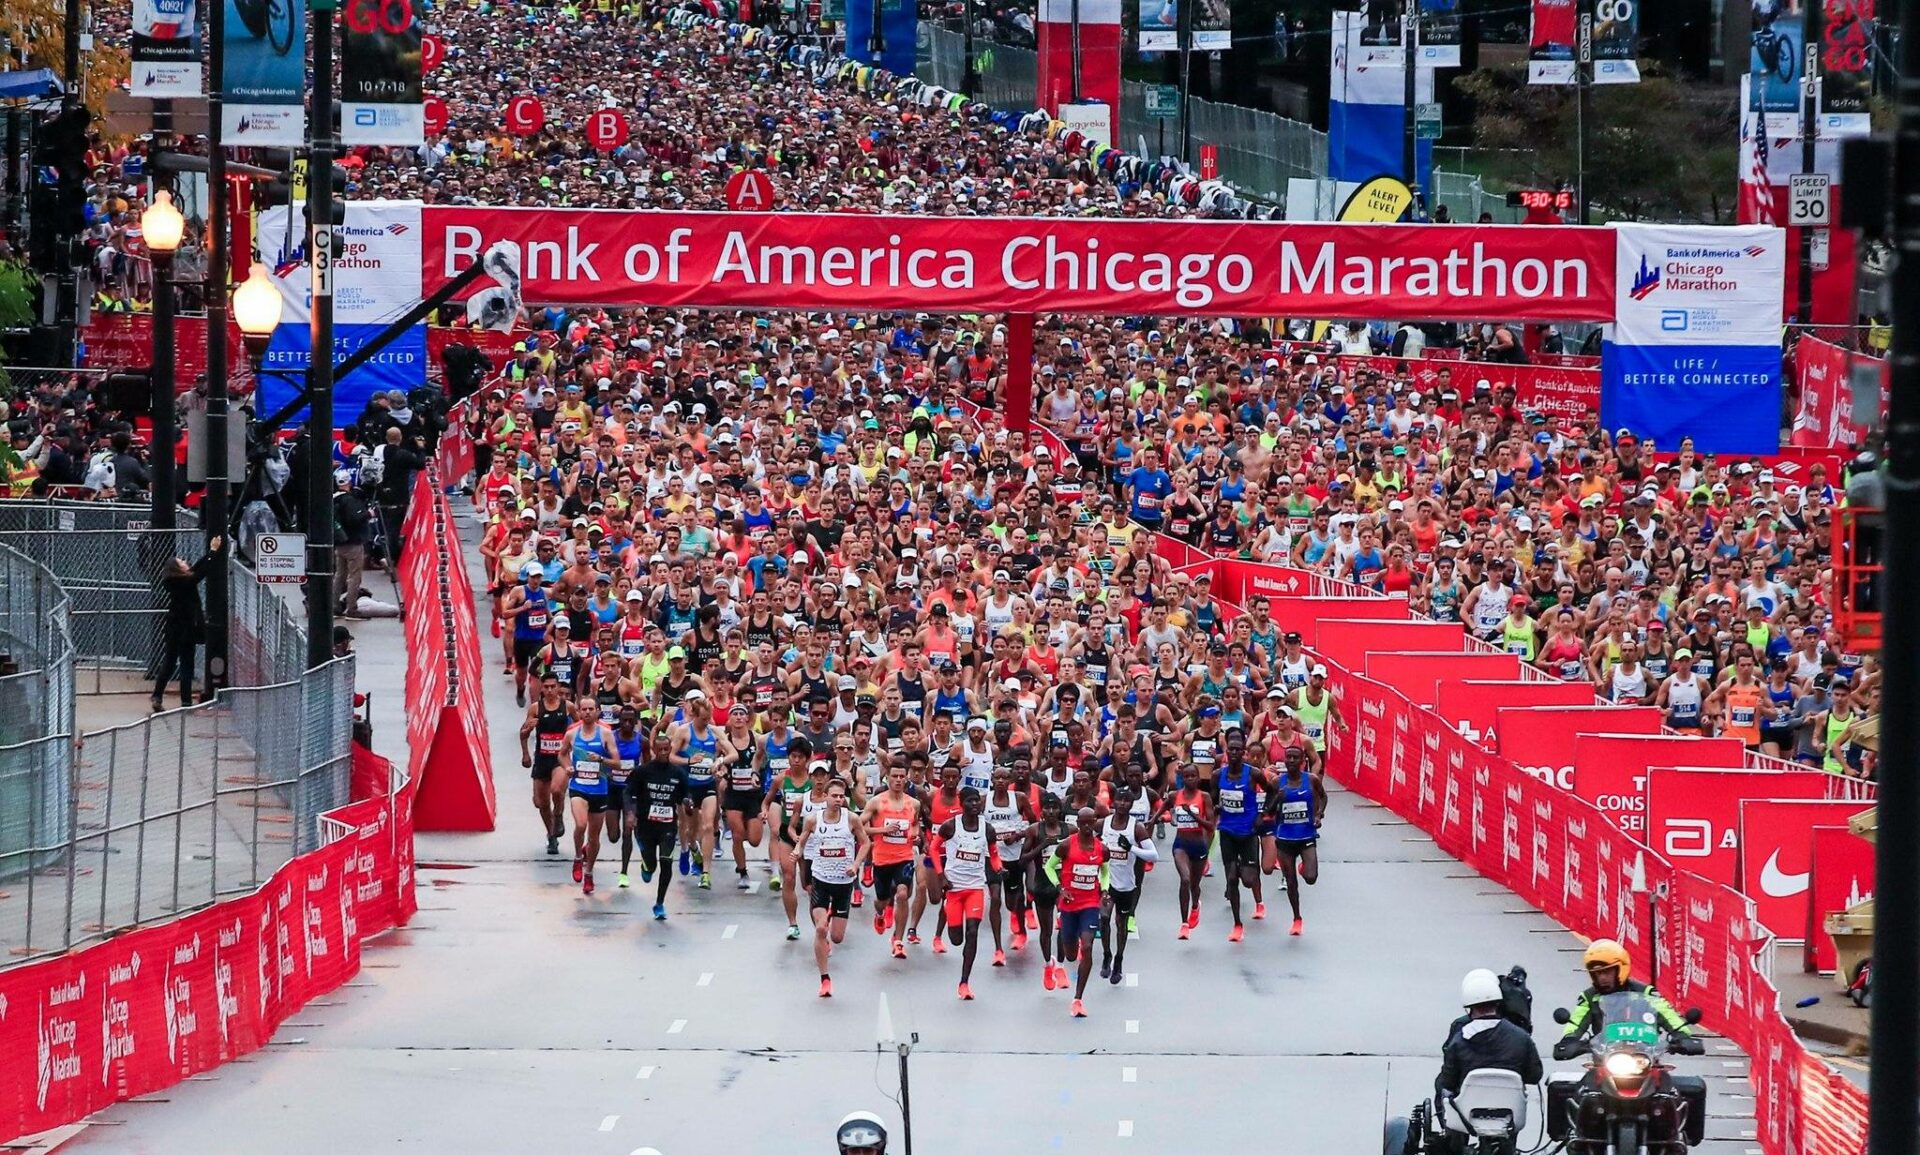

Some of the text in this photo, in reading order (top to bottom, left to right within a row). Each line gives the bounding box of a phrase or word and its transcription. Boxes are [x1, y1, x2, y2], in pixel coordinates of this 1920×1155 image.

[345, 0, 413, 34] GO
[232, 88, 296, 96] #ChicagoMarathon
[515, 100, 533, 124] C
[599, 113, 617, 140] B
[1068, 119, 1106, 132] aggreko
[736, 174, 763, 205] A
[1793, 178, 1827, 188] SPEED
[1370, 188, 1399, 204] ALERT
[1796, 188, 1823, 198] LIMIT
[1367, 199, 1396, 215] LEVEL
[1795, 200, 1825, 218] 30
[345, 227, 384, 236] America
[1666, 248, 1741, 259] Bank of America
[315, 231, 330, 290] C31
[333, 257, 381, 269] rathon
[444, 225, 1588, 308] Bnk of America Chicago Marathon
[1666, 262, 1724, 278] Chicago
[1666, 278, 1737, 291] Marathon
[1674, 359, 1705, 370] LIFE
[1624, 373, 1769, 386] BETTER CONNECTED
[1534, 394, 1587, 415] Chicago
[990, 813, 1011, 821] ARMY
[823, 849, 841, 857] RUPP
[1617, 1027, 1635, 1036] TV
